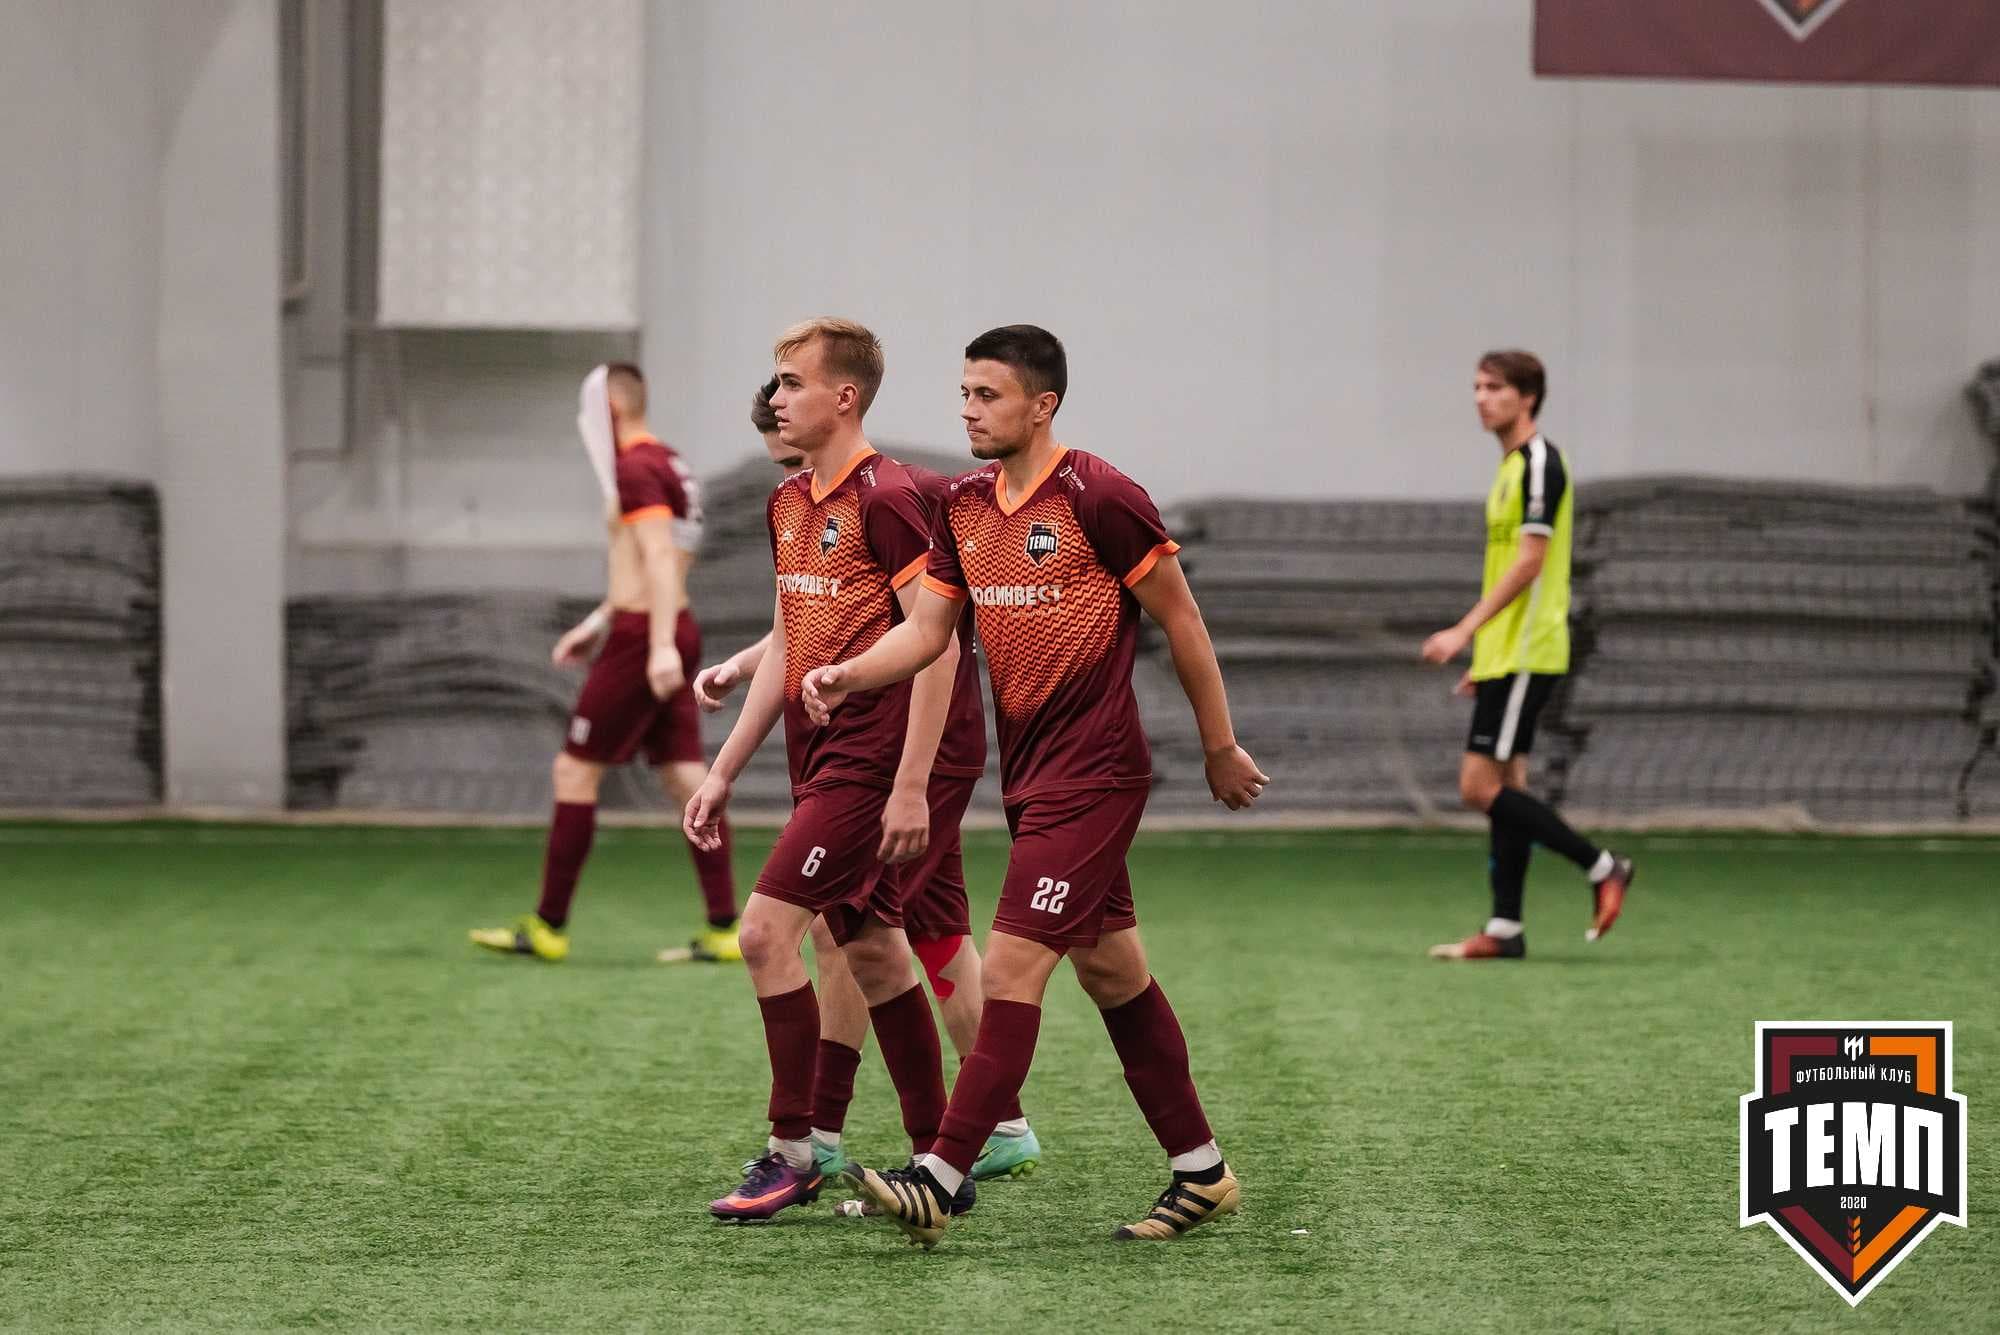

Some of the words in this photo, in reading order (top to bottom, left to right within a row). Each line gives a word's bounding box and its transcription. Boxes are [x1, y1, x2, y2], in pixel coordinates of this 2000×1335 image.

[1029, 535, 1055, 551] ТЕМП
[801, 846, 826, 877] 6
[1030, 877, 1070, 914] 22
